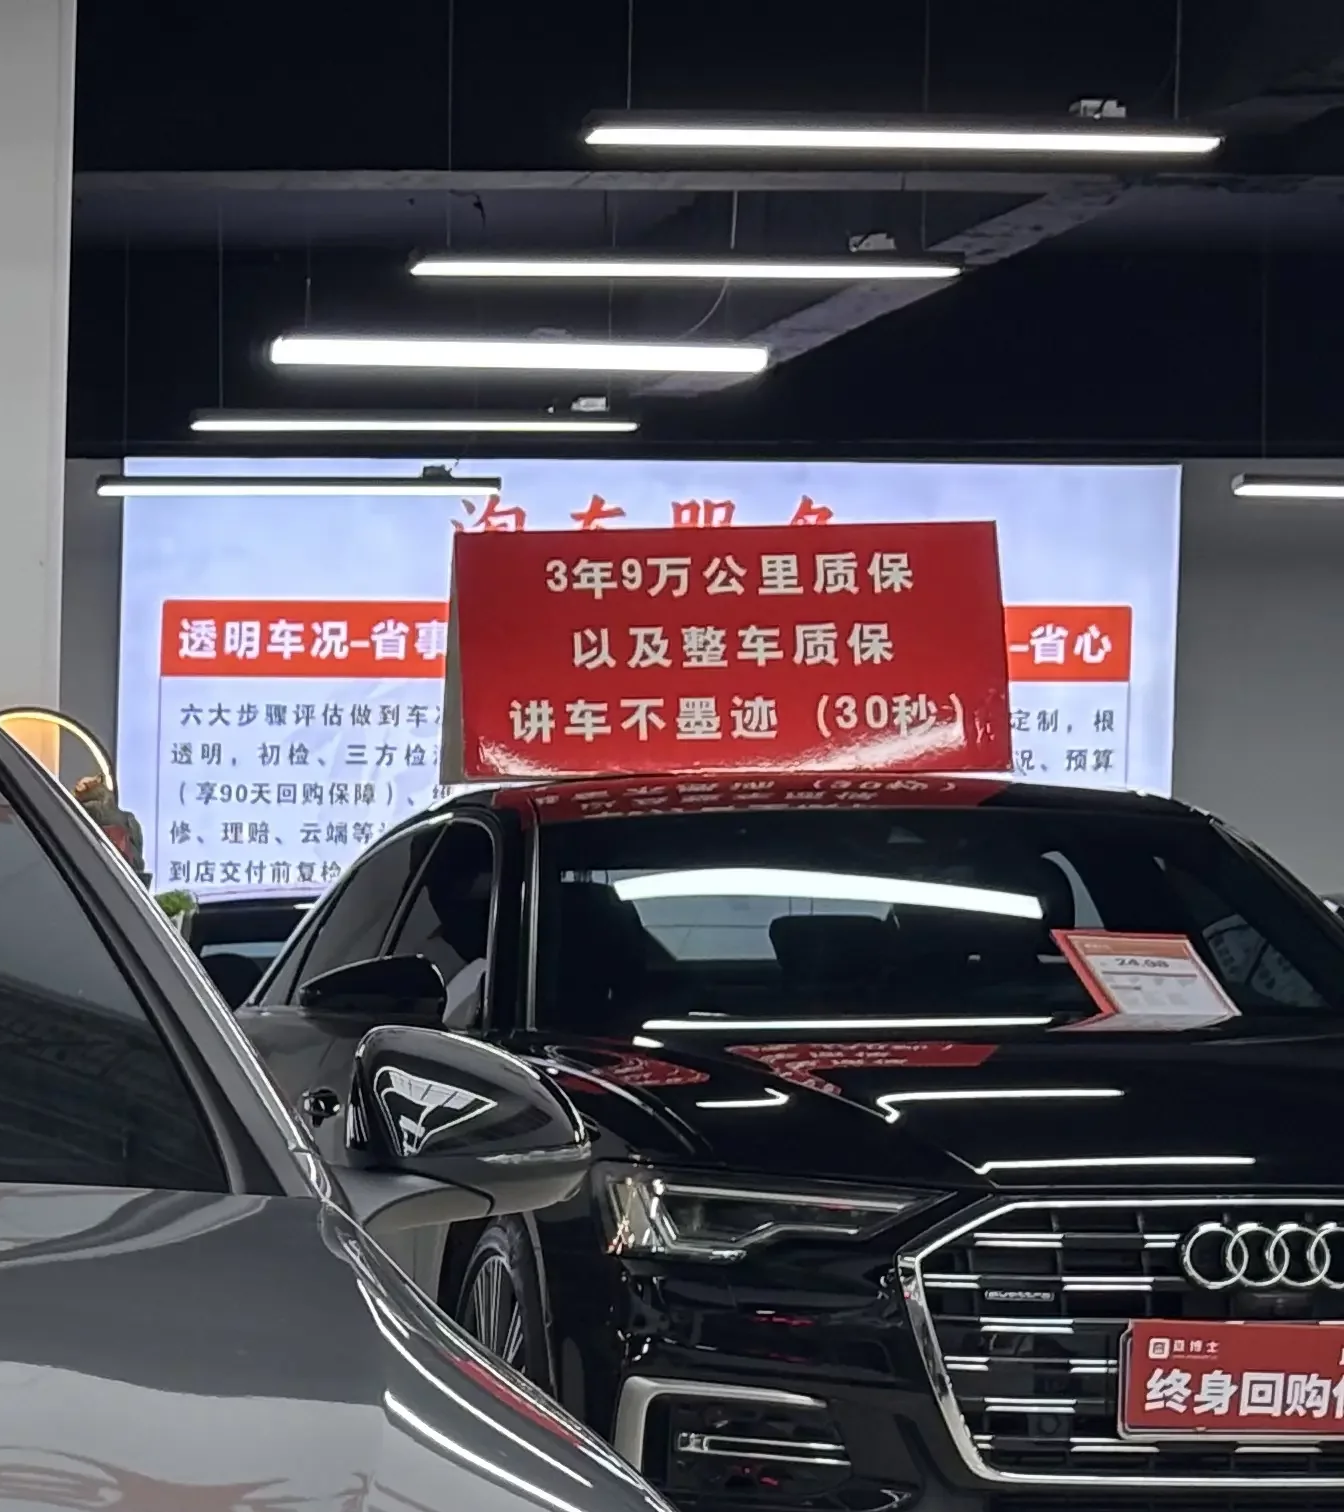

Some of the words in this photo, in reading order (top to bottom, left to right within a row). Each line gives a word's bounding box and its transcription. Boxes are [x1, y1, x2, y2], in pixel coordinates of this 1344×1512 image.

[546, 552, 915, 599] 3年9万公里质保
[572, 623, 896, 669] 以及整车质保
[180, 703, 441, 730] 六大步骤评估做到车
[171, 743, 441, 770] 透明，初检、三方检
[170, 820, 386, 846] 修、理赔、云端等
